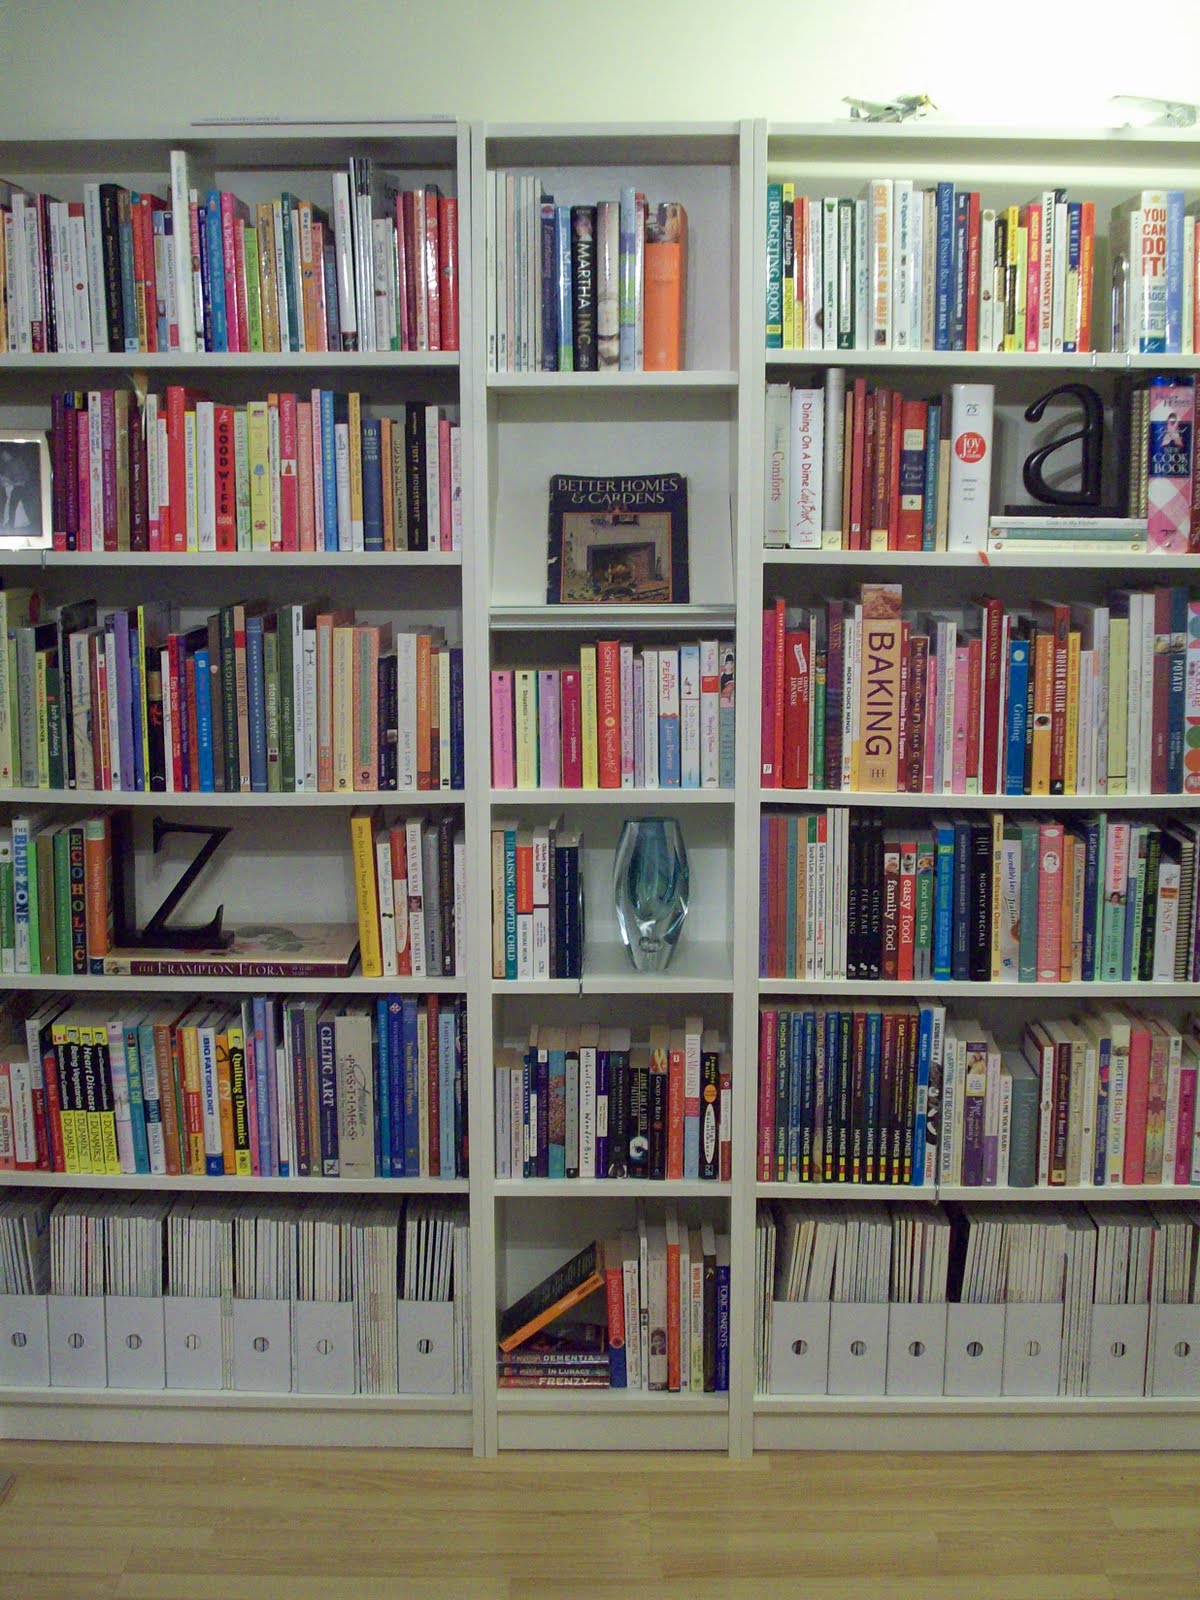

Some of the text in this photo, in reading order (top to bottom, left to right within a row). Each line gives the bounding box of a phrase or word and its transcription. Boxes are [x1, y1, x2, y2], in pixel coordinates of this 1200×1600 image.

[1143, 224, 1166, 236] CAN
[1144, 208, 1166, 222] YOU
[768, 201, 780, 321] BUDGETING BOOK
[1142, 237, 1165, 255] DO
[1141, 257, 1166, 277] IT!
[577, 243, 592, 349] MARTHA INC.
[1043, 271, 1051, 307] MONEY
[802, 403, 812, 432] Dining
[802, 435, 812, 449] On
[1153, 453, 1189, 463] COOK
[218, 424, 229, 514] GOOD WIFE
[558, 478, 678, 492] BETTER HOMES
[771, 451, 785, 501] Comforts
[802, 463, 811, 486] Dime
[1154, 463, 1189, 474] BOOK
[571, 492, 664, 504] & GARDENS
[990, 610, 998, 659] CHRISTMAS
[224, 648, 232, 691] SEASONS
[662, 660, 670, 701] PERFECT
[1056, 648, 1067, 713] MODERN GRILLING
[1172, 660, 1183, 692] POTATO
[268, 683, 278, 739] storage style
[865, 632, 895, 756] BAKING
[49, 722, 60, 756] gardening
[1011, 704, 1023, 741] Grilling
[15, 834, 29, 924] BLUE ZONE
[506, 851, 514, 886] RAISING
[884, 880, 897, 951] family food
[901, 879, 913, 944] easy food
[919, 879, 930, 944] food with flair
[1162, 901, 1173, 933] PASTA
[157, 962, 284, 976] FRAMPTON FLORA
[203, 1037, 211, 1055] BIG
[898, 1024, 905, 1036] GM
[70, 1046, 82, 1109] Being Vegetarian
[83, 1047, 95, 1111] Heart Disease
[204, 1057, 212, 1075] FAT
[321, 1026, 334, 1106] CELTIC ART
[233, 1053, 246, 1145] Quilting Dummies
[1113, 1059, 1124, 1154] BETTER Baby FOOD
[64, 1118, 75, 1160] DUMMIES
[77, 1118, 88, 1157] DUMMIES
[90, 1120, 101, 1163] DUMMIES
[104, 1120, 115, 1162] DUMMIES
[825, 1126, 833, 1153] HAYNES
[904, 1129, 912, 1156] HAYNES
[943, 1087, 953, 1170] GET READY FOR BABY BOOK
[967, 1106, 975, 1142] Pregnancy
[539, 1377, 588, 1385] FRENZY
